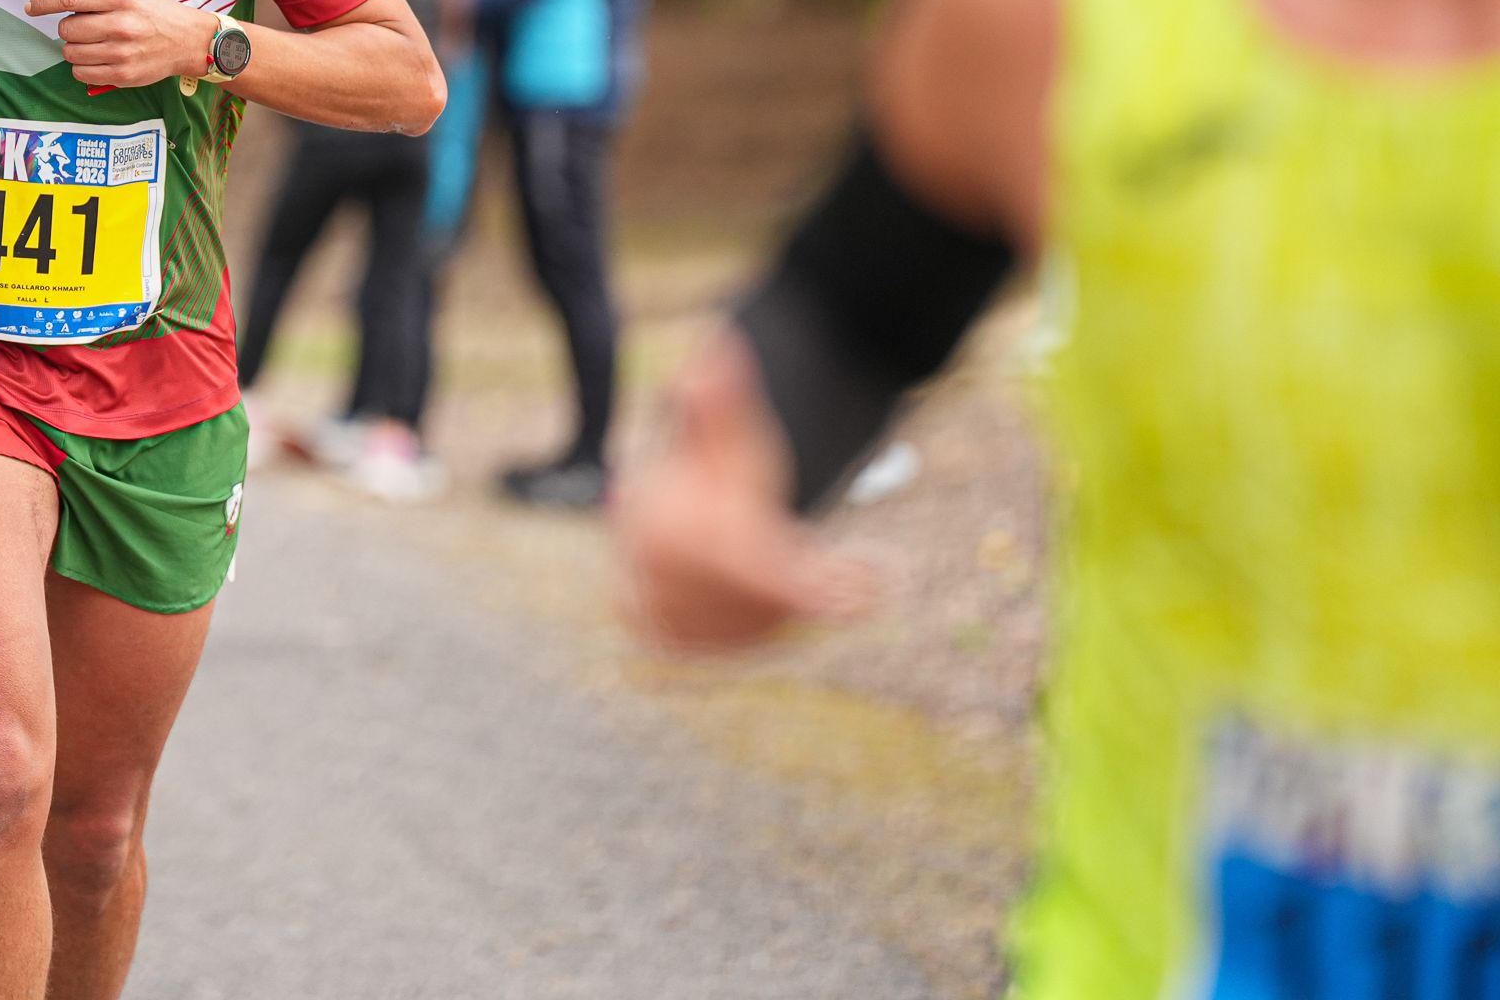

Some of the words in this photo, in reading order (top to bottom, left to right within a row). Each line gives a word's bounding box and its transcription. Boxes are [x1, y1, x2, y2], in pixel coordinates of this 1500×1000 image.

[77, 138, 98, 148] Ciudad
[99, 140, 107, 149] de
[113, 143, 146, 156] carreras
[77, 147, 106, 158] LUCENA
[113, 150, 153, 167] populares
[75, 167, 106, 184] 2026
[11, 283, 51, 291] GALLARDO
